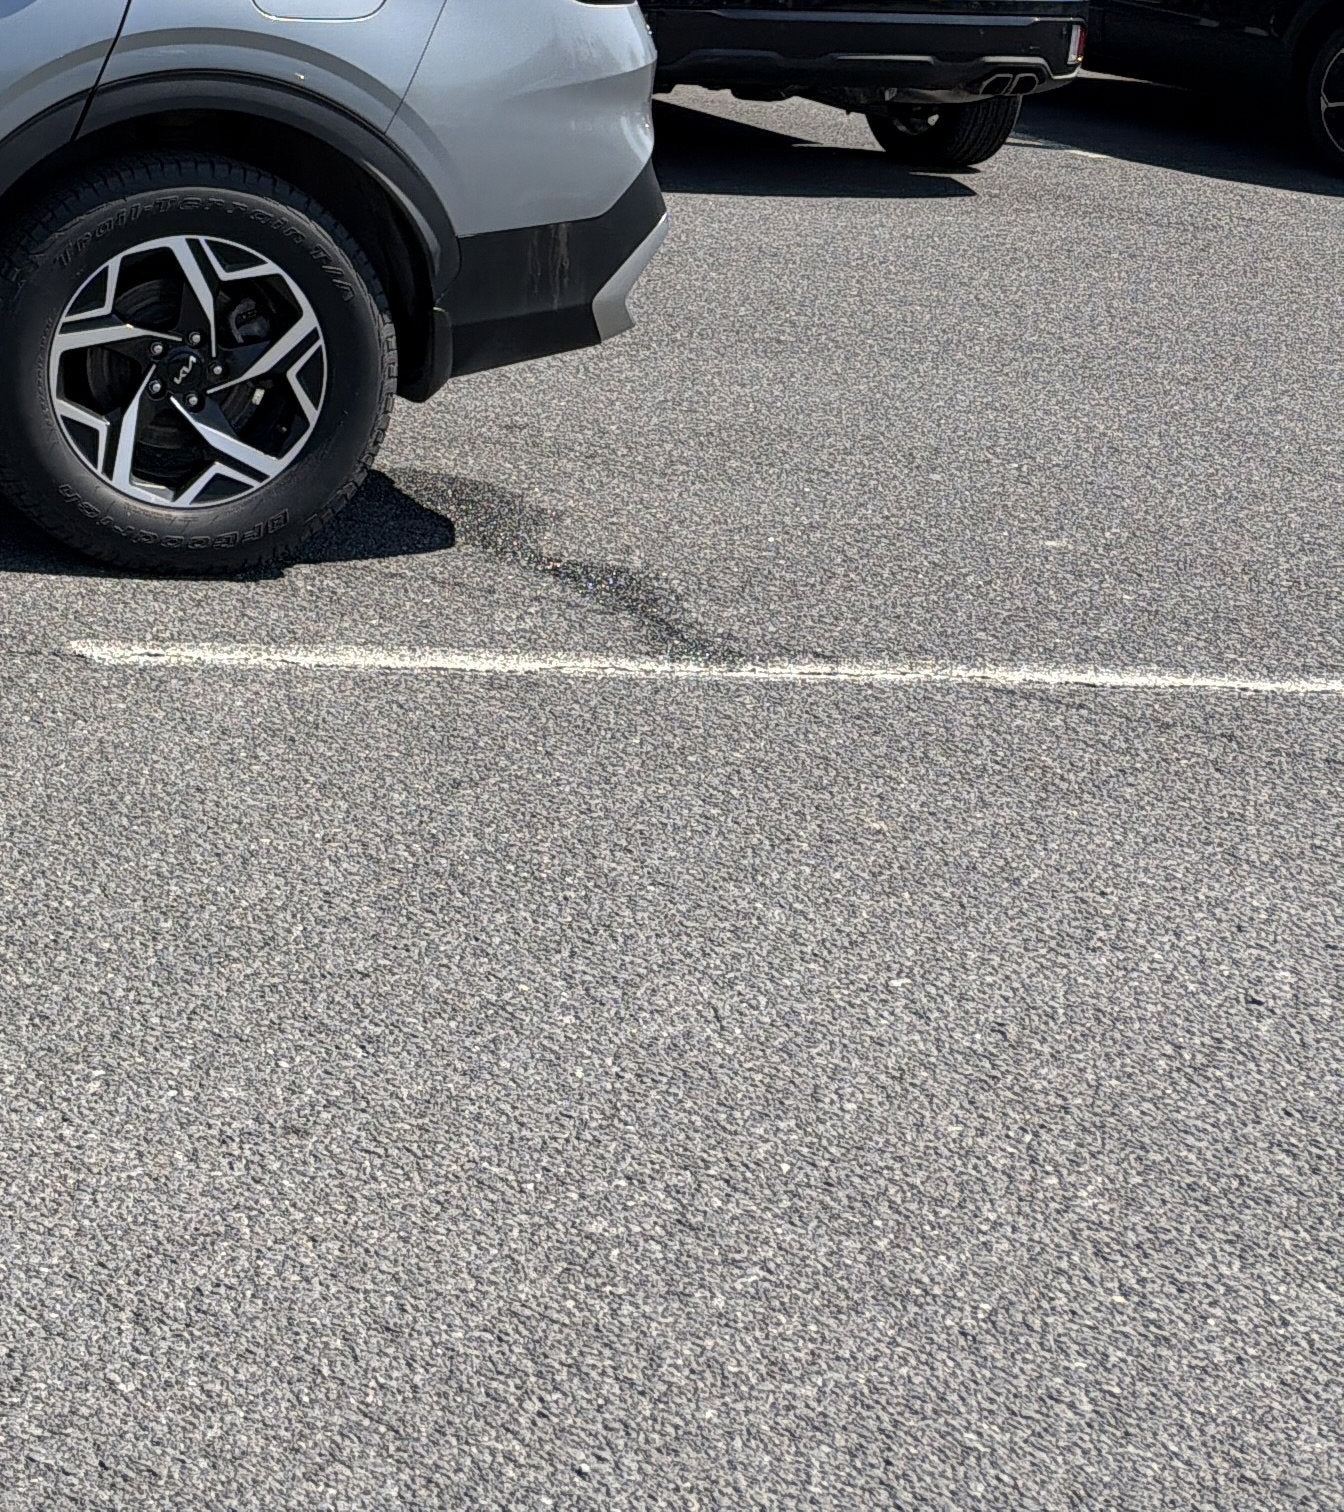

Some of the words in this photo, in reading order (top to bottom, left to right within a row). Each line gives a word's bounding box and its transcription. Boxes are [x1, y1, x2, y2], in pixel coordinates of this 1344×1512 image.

[56, 195, 306, 266] Trail-Terrain
[310, 244, 355, 302] T/A
[59, 484, 289, 549] BFGoodrich
